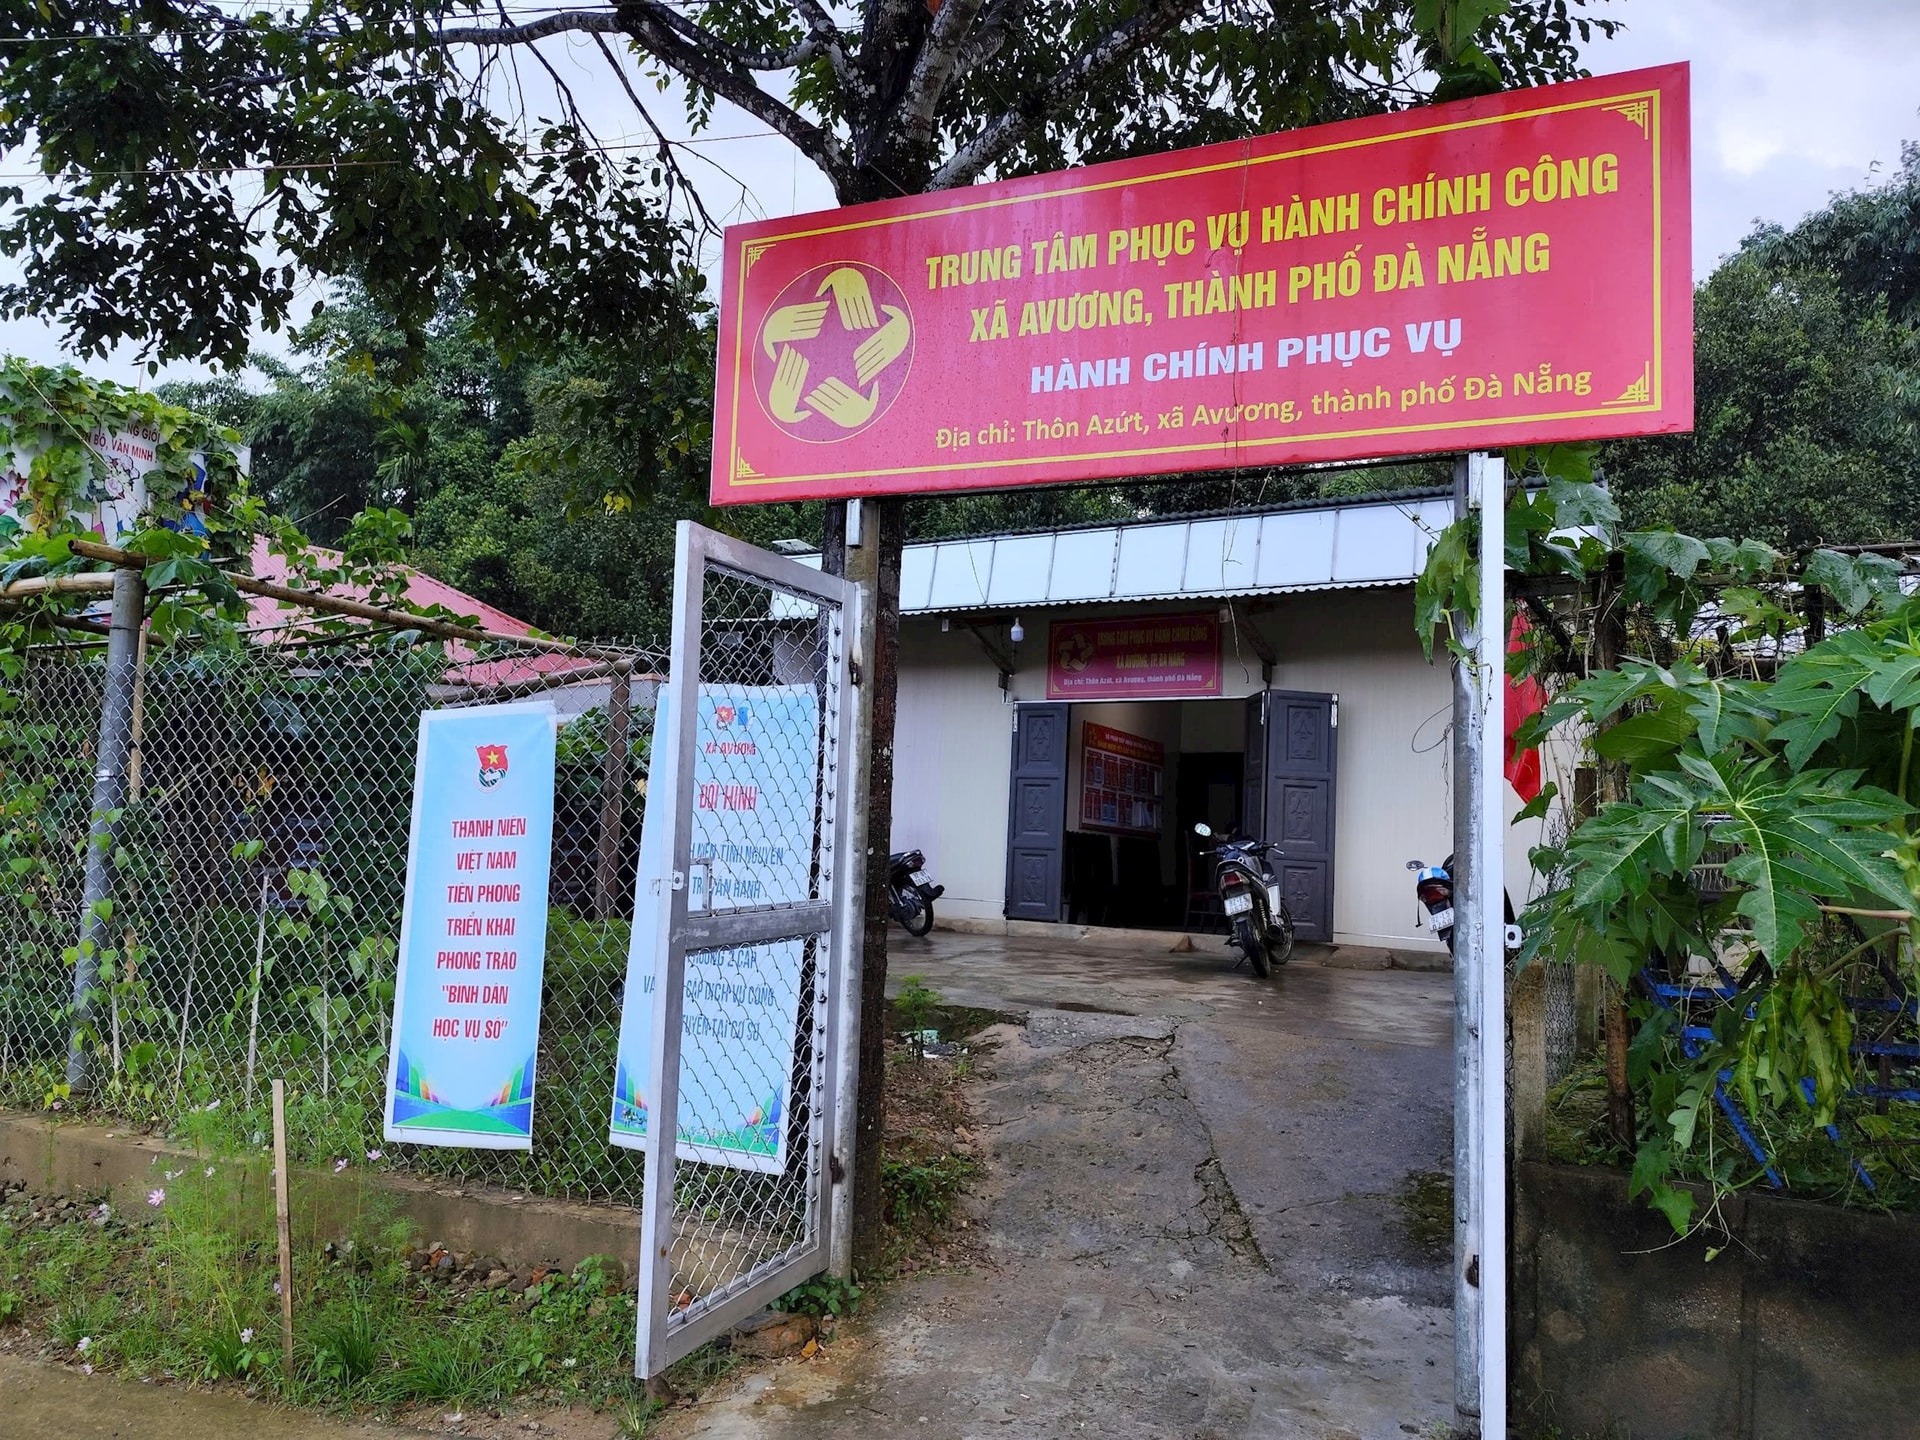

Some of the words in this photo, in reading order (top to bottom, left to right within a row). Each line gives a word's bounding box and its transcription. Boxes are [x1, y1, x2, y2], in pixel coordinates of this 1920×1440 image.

[925, 244, 1022, 290] TRUNG
[1031, 231, 1098, 275] TÂM
[1107, 219, 1195, 266] PHỤC
[1206, 210, 1249, 255] VỤ
[1261, 192, 1360, 243] HÀNH
[1372, 172, 1491, 227] CHÍNH
[1505, 153, 1618, 207] CÔNG
[969, 298, 1009, 343] XÃ
[1018, 287, 1153, 337] AVƯƠNG,
[1164, 269, 1277, 319] THÀNH
[1288, 243, 1363, 304] PHỐ
[1373, 242, 1425, 293] ĐÀ
[1438, 225, 1550, 285] NẴNG
[1031, 356, 1130, 394] HÀNH
[1143, 338, 1264, 382] CHÍNH
[1277, 326, 1391, 368] PHỤC
[1405, 317, 1462, 357] VỤ
[936, 427, 971, 453] Địa
[977, 420, 1016, 446] chỉ:
[1022, 418, 1079, 442] Thôn
[1086, 410, 1150, 436] Azứt,
[1157, 406, 1184, 431] xã
[1191, 398, 1303, 427] Avương,
[1312, 385, 1391, 416] thành
[1401, 375, 1457, 412] phố
[1463, 374, 1502, 401] Đà
[1513, 363, 1592, 397] Nẵng
[111, 438, 130, 458] VĂN
[131, 445, 154, 461] MINH
[452, 820, 494, 838] THANH
[497, 815, 527, 837] NIÊN
[457, 849, 483, 874] VIỆT
[486, 851, 517, 870] NAM
[477, 884, 521, 903] PHONG
[447, 911, 482, 936] TRIỂN
[486, 918, 516, 936] KHAI
[437, 951, 481, 970] PHONG
[486, 948, 518, 970] TRÀO
[482, 982, 509, 1004] DÂN
[433, 1019, 460, 1041] HỌC
[465, 1019, 481, 1042] VỤ
